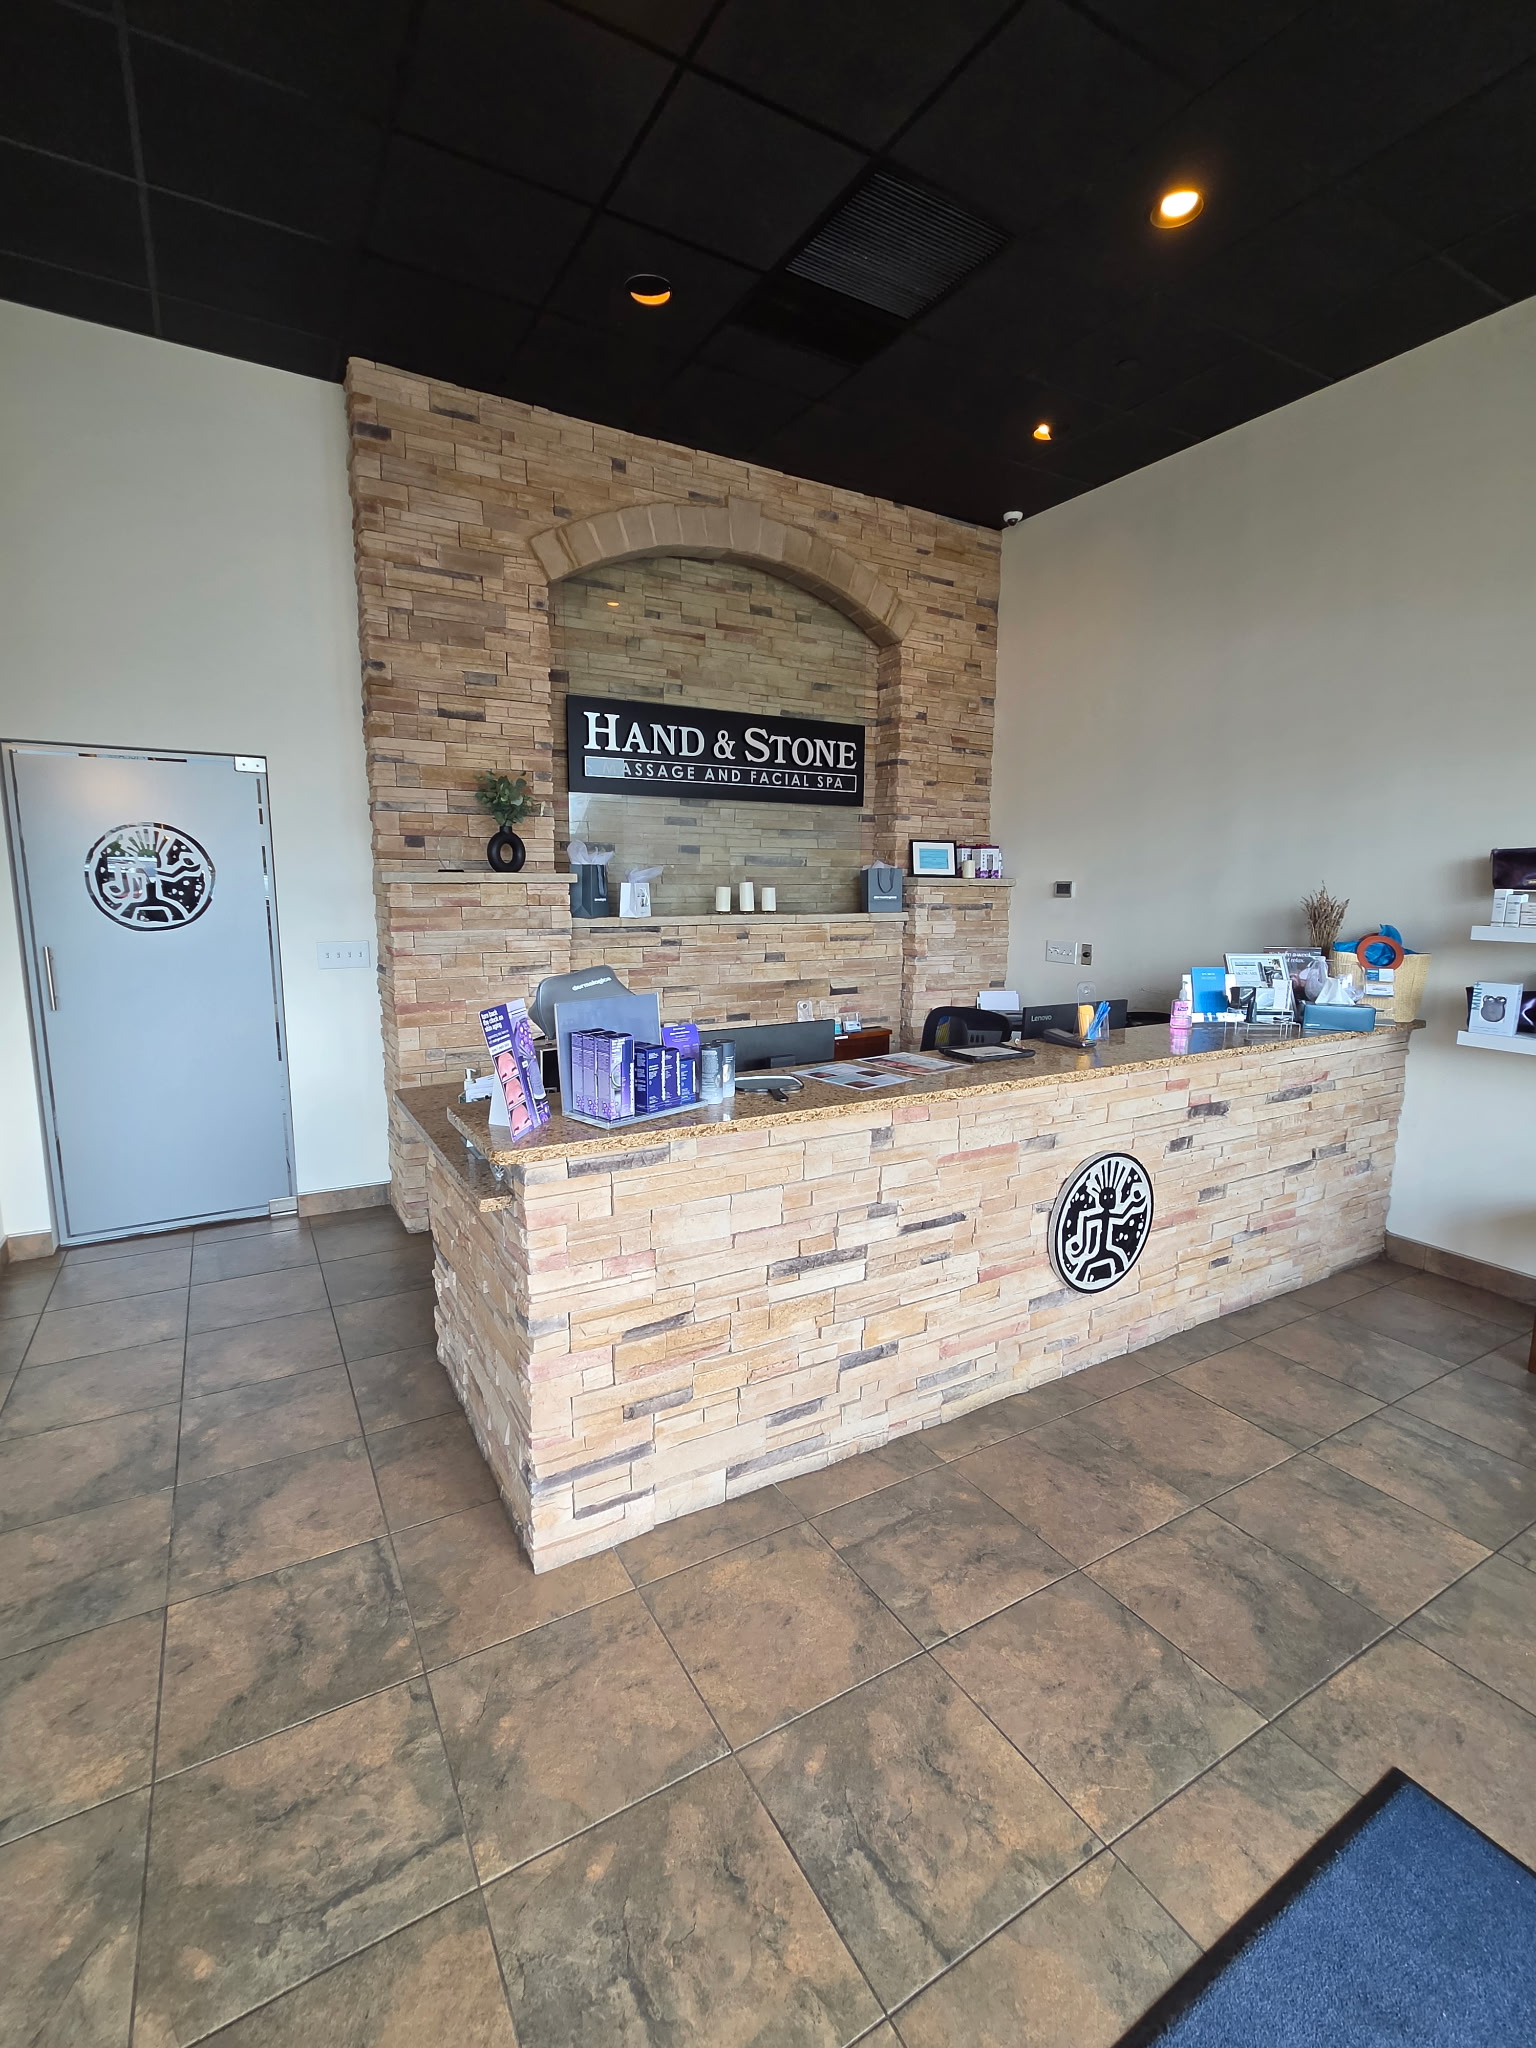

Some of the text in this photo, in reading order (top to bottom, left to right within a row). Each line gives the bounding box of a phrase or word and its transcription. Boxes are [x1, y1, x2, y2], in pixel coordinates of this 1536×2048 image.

[583, 711, 857, 769] HAND & STONE
[704, 766, 741, 782] AND
[750, 771, 809, 787] FACIAL
[817, 775, 844, 789] SPA
